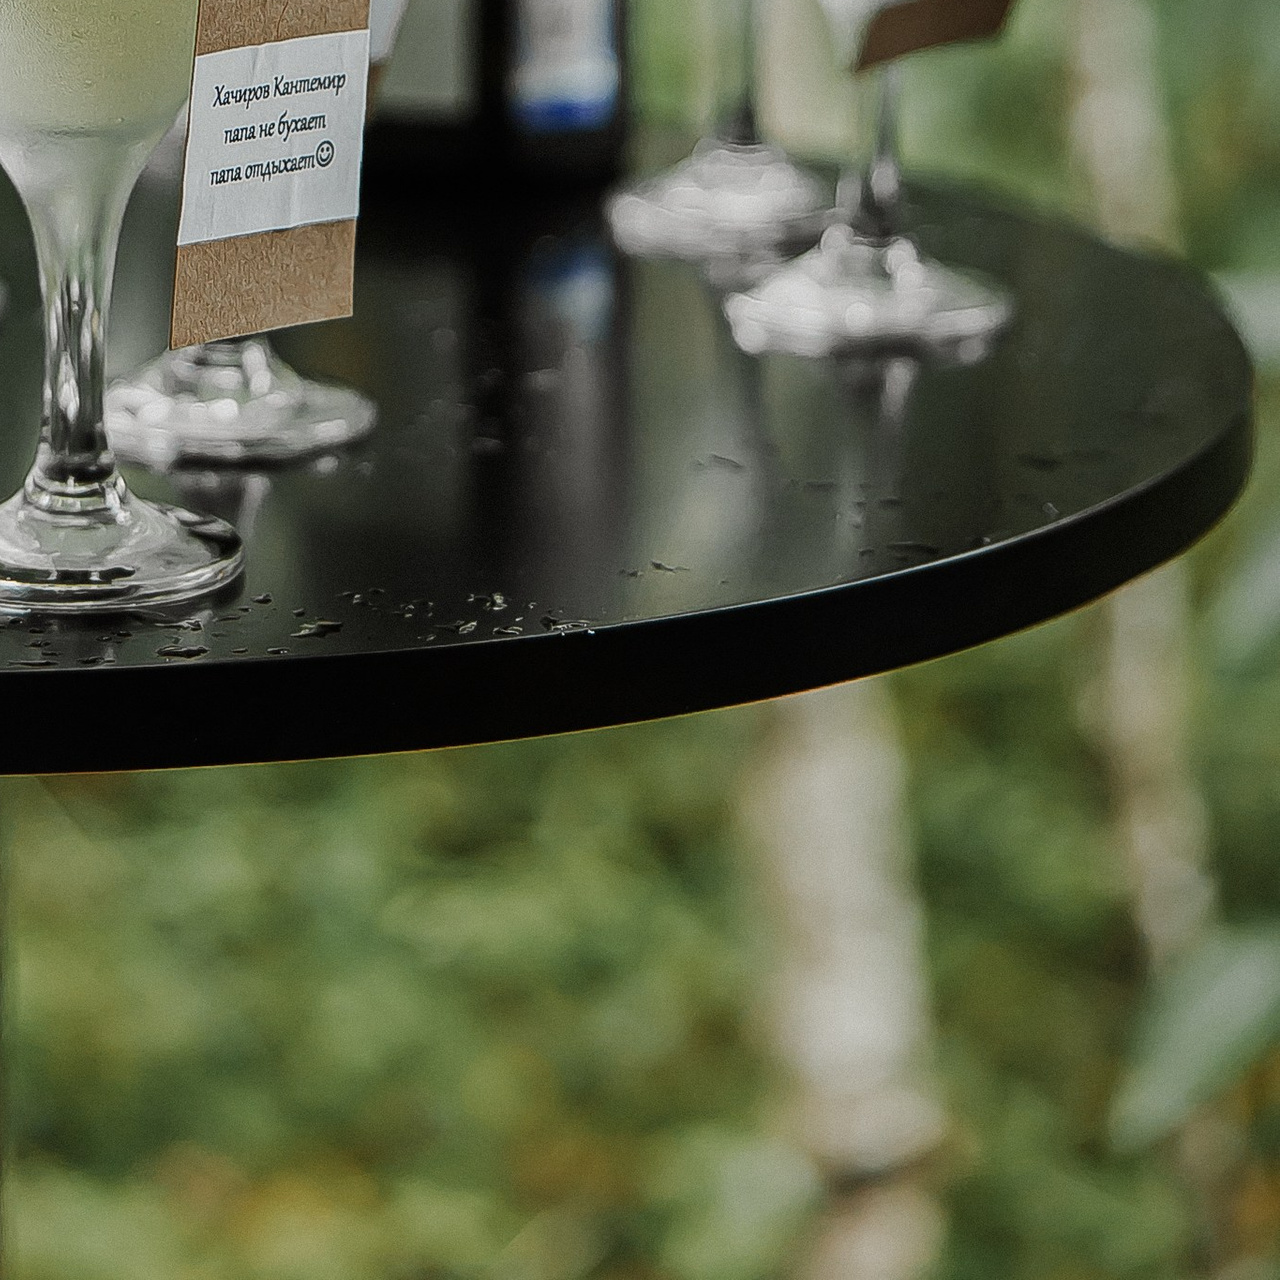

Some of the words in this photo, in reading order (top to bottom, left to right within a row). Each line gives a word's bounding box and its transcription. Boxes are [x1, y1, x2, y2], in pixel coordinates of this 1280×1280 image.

[213, 85, 269, 109] Хачиров
[274, 73, 346, 96] Кантемир
[224, 124, 256, 144] папа
[259, 121, 275, 138] не
[278, 111, 326, 142] бухает
[210, 166, 242, 185] папа
[245, 154, 315, 182] отдыхает
